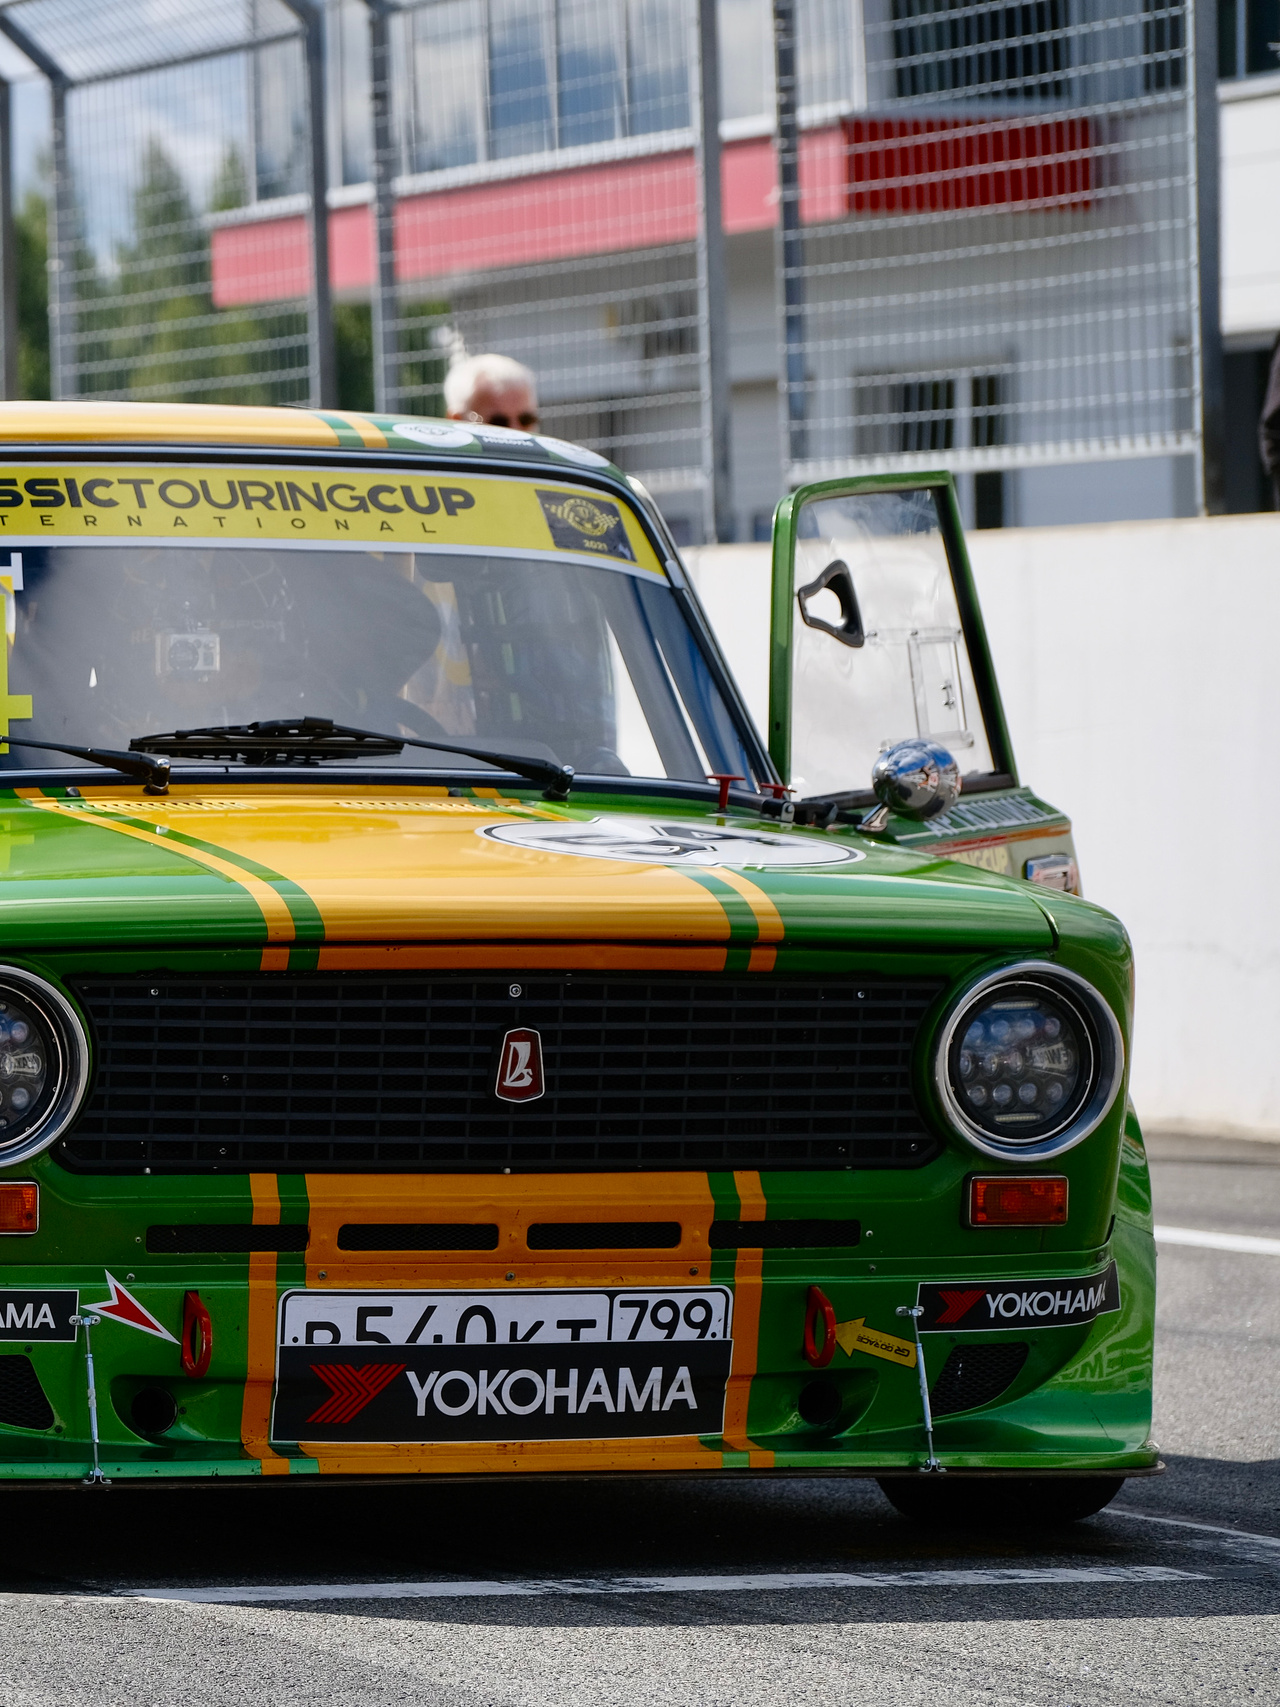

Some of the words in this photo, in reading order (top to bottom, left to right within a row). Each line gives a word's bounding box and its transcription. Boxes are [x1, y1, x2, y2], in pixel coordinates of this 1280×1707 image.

[619, 1298, 714, 1340] 799
[986, 1280, 1107, 1319] YOKOHAMA
[406, 1365, 699, 1417] YOKOHAMA
